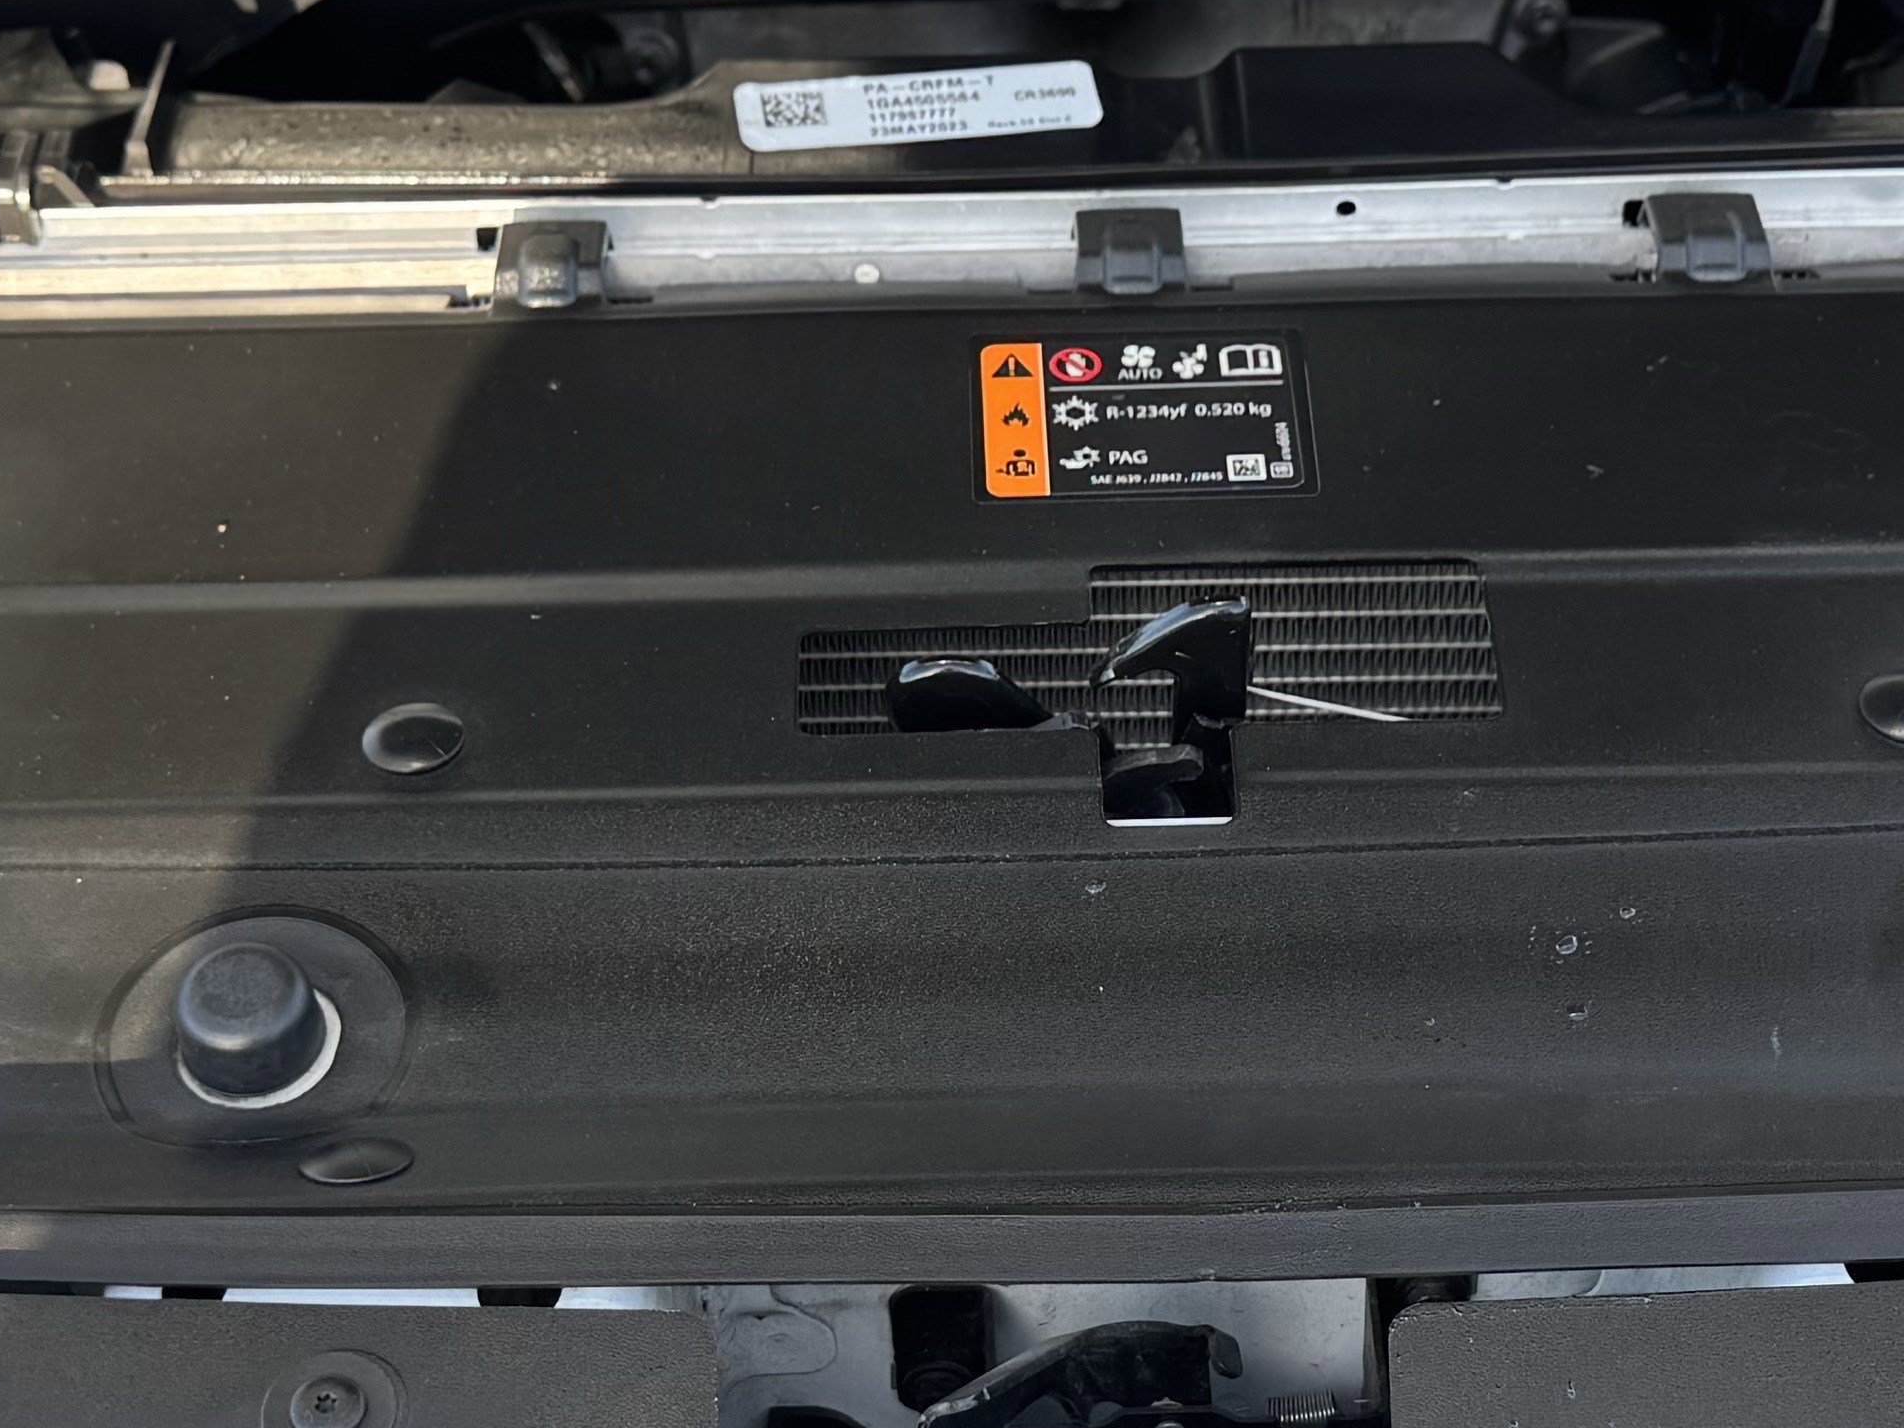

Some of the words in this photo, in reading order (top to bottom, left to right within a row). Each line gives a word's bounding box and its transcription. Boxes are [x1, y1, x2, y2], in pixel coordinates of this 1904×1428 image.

[1117, 366, 1163, 381] AUTO
[1106, 403, 1187, 421] R-1234yf
[1194, 402, 1244, 418] 0.520
[1248, 401, 1272, 419] kg
[1108, 449, 1149, 465] PAG
